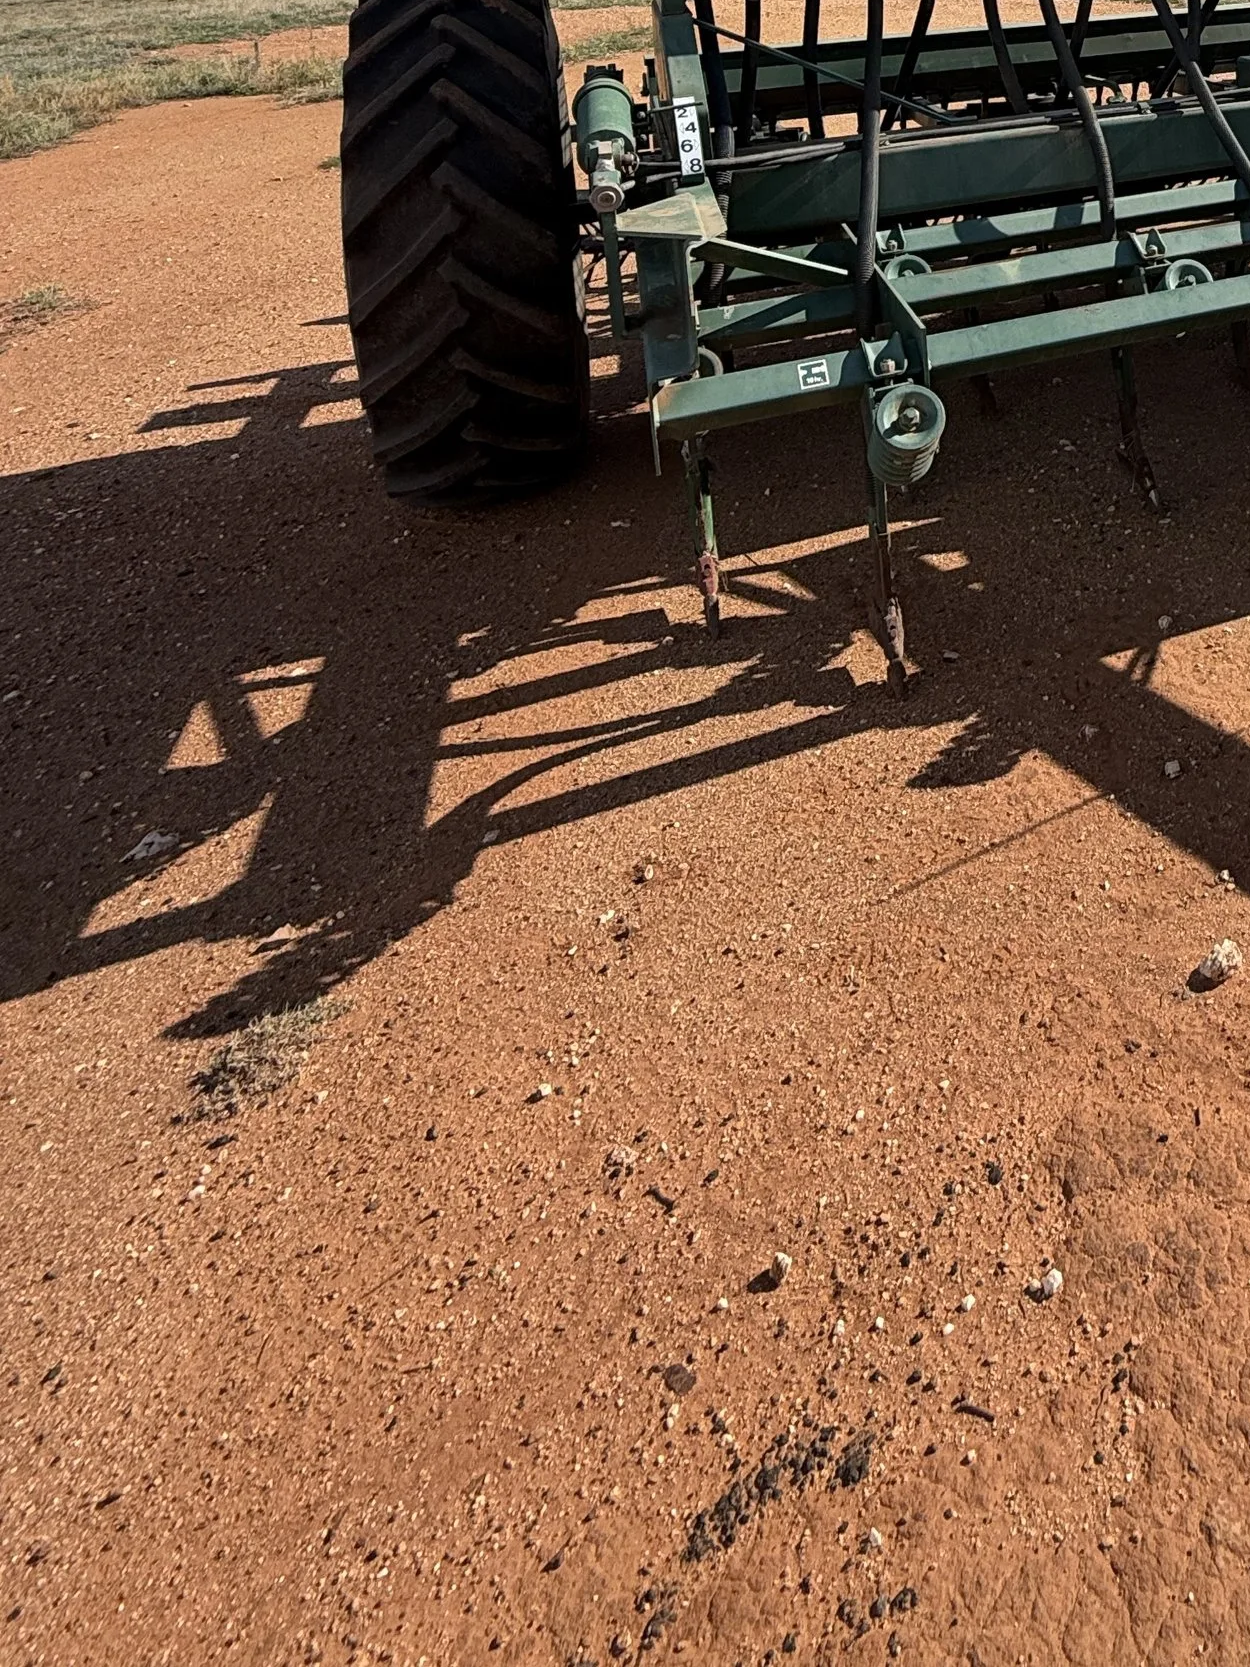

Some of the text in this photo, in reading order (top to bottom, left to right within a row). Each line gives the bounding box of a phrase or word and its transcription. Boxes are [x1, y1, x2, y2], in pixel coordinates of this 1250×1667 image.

[676, 107, 688, 118] 2
[685, 122, 697, 133] 4
[681, 139, 693, 153] 6
[690, 158, 702, 173] 8
